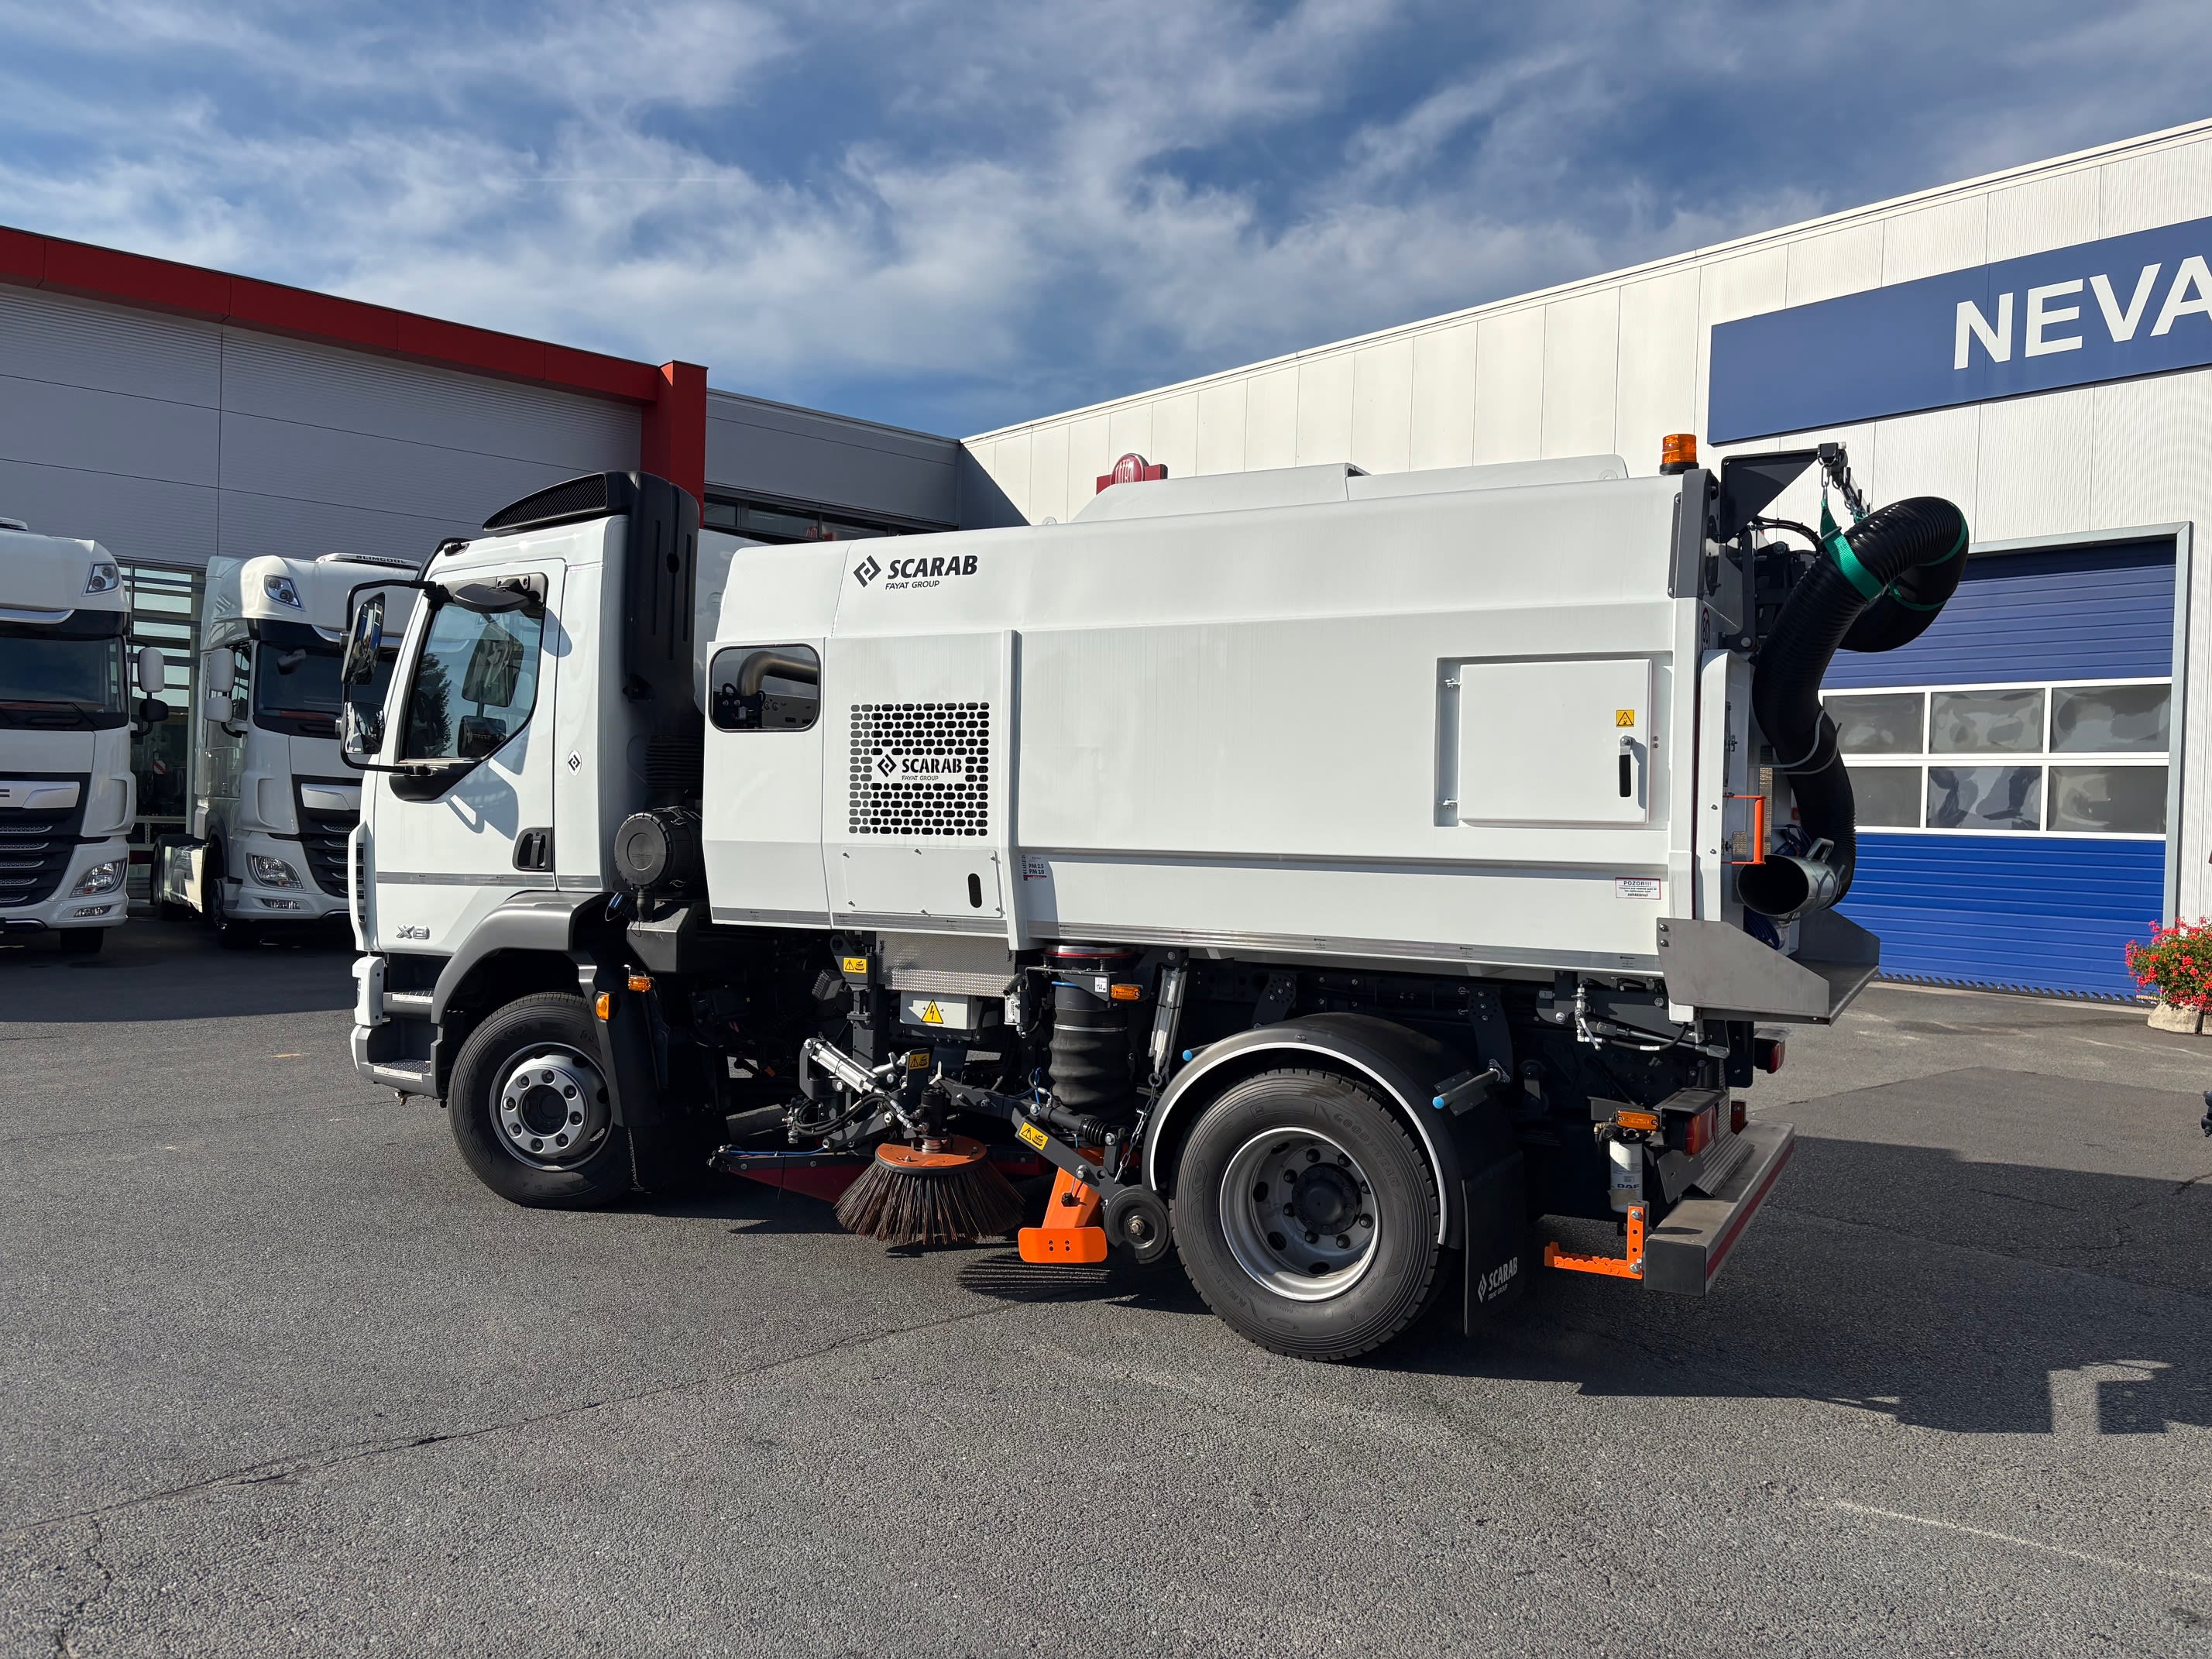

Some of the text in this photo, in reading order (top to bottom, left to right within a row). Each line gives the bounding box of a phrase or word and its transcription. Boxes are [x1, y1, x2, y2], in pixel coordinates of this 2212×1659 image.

[1954, 255, 2212, 370] NEVA
[356, 555, 407, 564] SLIMCOOL
[887, 555, 978, 579] SCARAB
[884, 580, 939, 590] FAYAT GROUP
[902, 758, 962, 774] SCARAB
[1489, 1256, 1518, 1292] SCARAB
